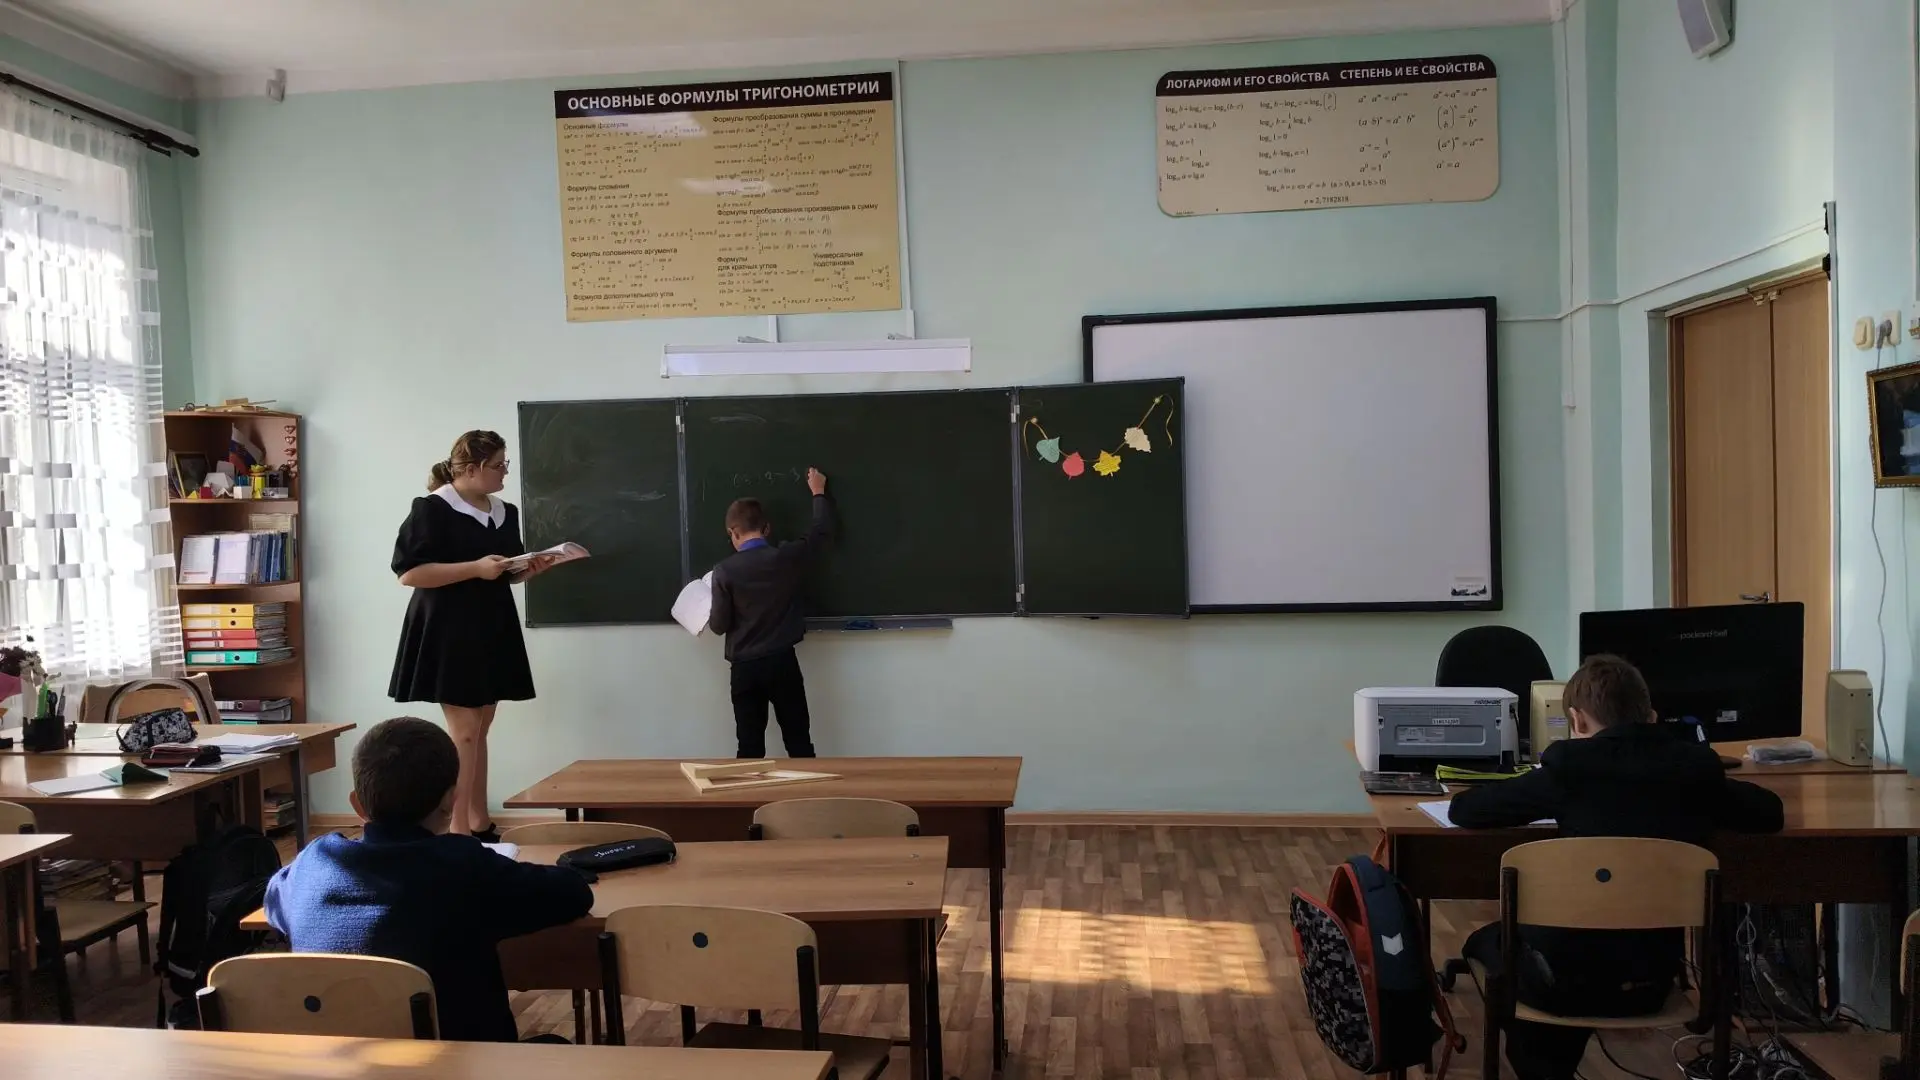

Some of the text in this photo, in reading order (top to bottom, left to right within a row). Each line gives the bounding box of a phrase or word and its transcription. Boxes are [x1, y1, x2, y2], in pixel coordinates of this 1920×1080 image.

[1340, 62, 1486, 80] СТЕПЕНЬ И ЕЕ СВОЙСТВА
[1166, 72, 1330, 89] ЛОГАРИФМ И ЕГО СВОЙСТВА
[567, 80, 880, 110] ОСНОВНЫЕ ФОРМУЛЫ ТРИГОНОМЕТРИИ
[712, 114, 744, 123] Формулы
[800, 111, 822, 119] суммы
[716, 208, 748, 216] Формулы
[857, 203, 879, 211] сумму
[716, 256, 748, 264] Формулы
